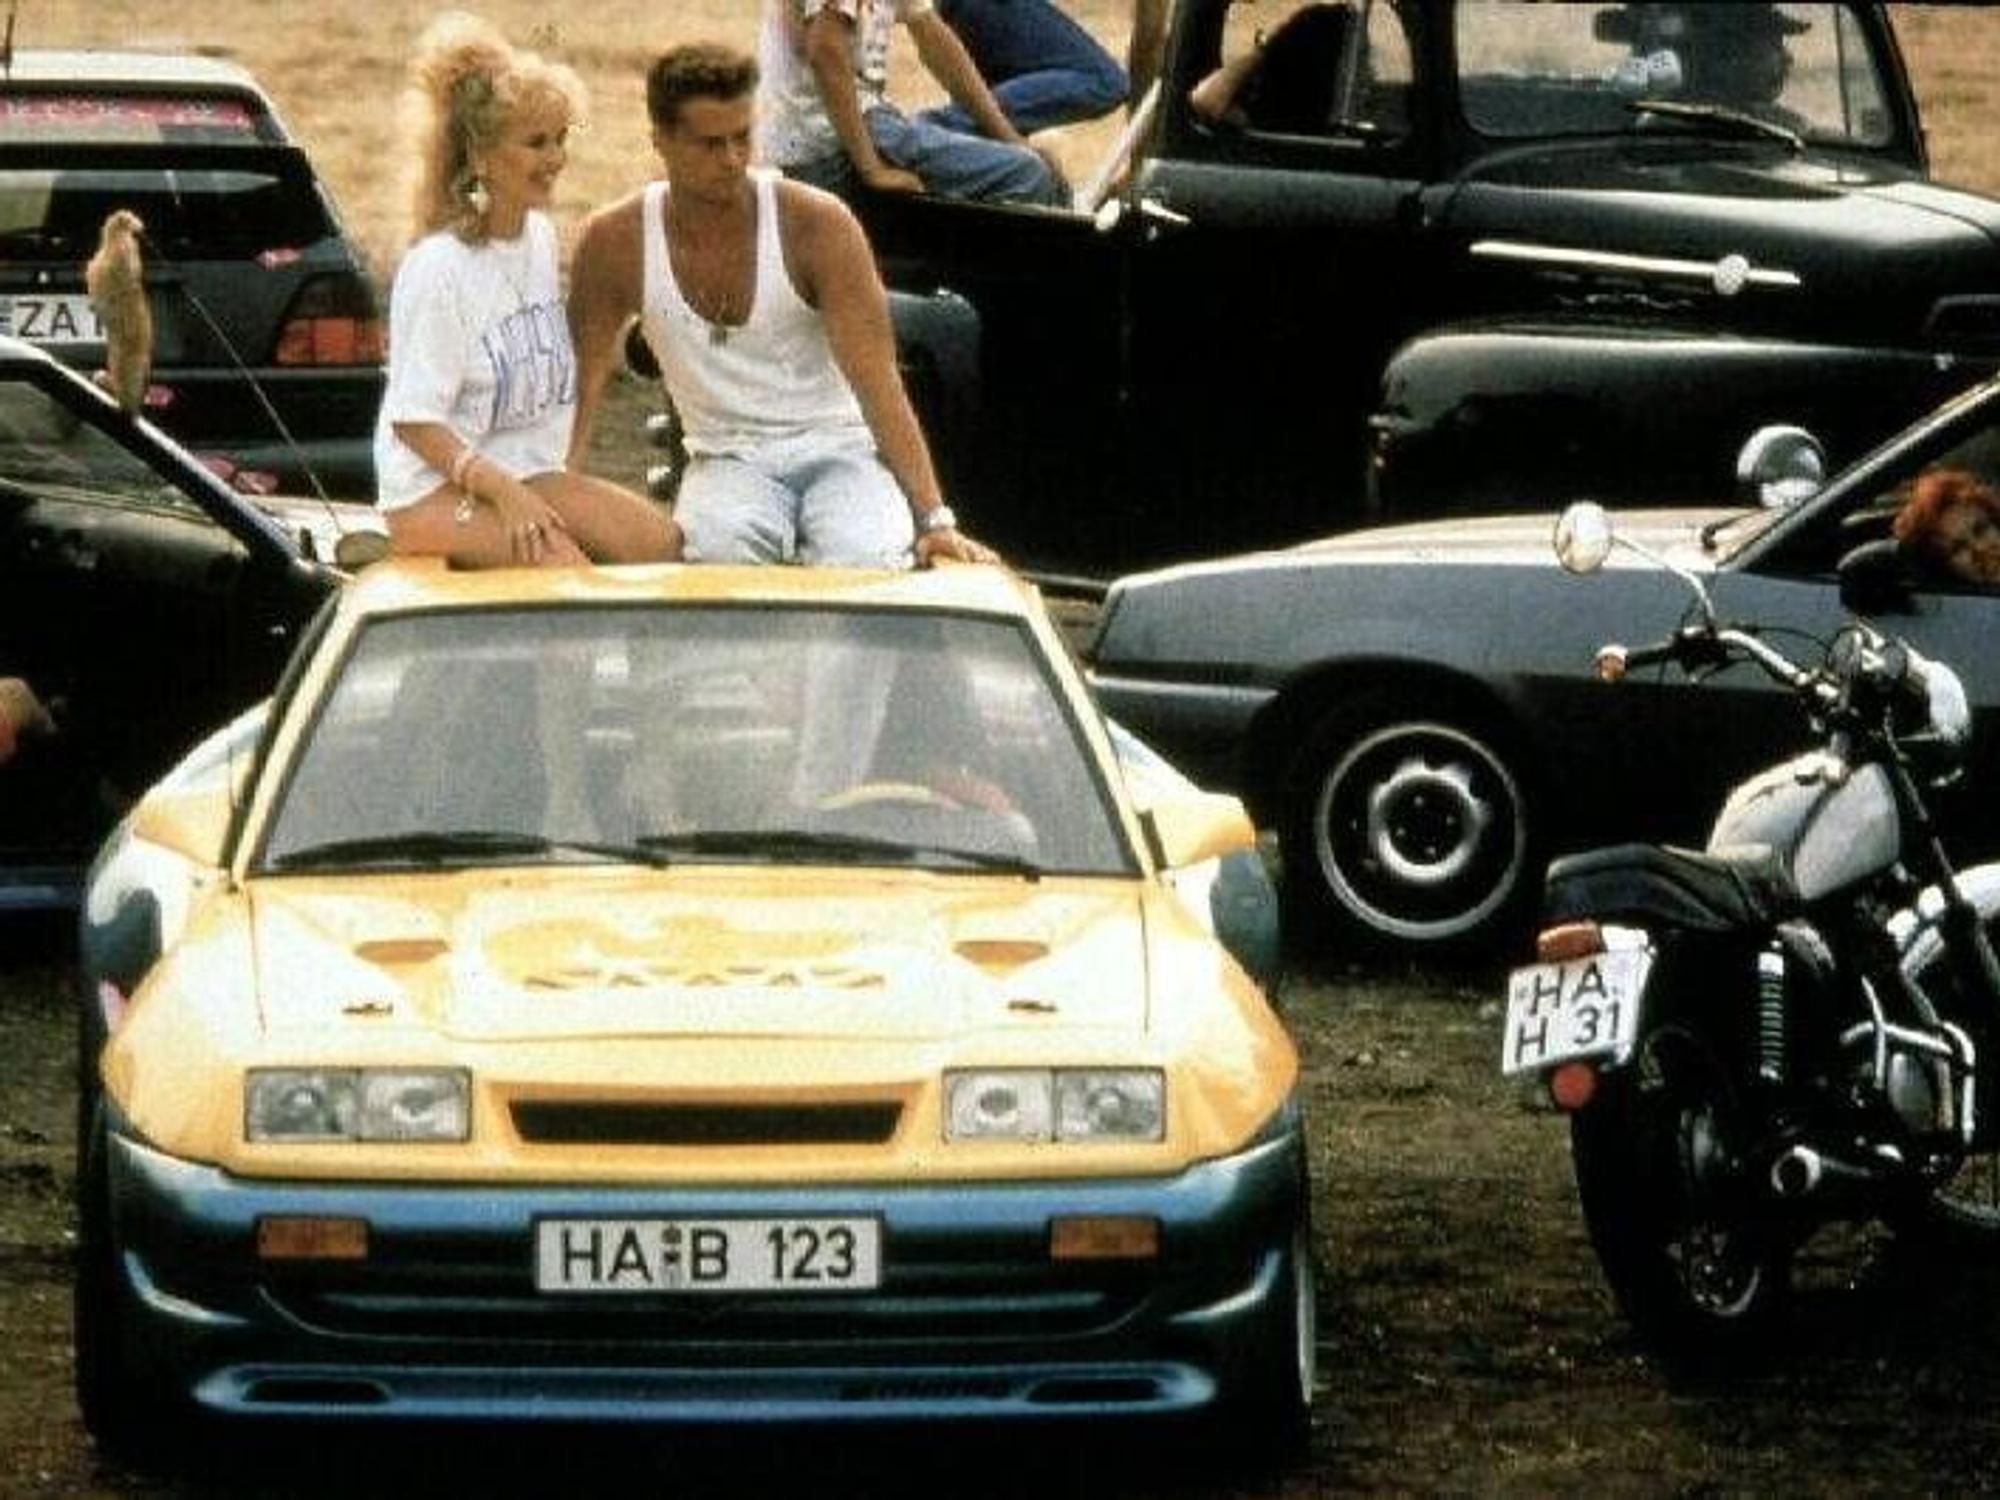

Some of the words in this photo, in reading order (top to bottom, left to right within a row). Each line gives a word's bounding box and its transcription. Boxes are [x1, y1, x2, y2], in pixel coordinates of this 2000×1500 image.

[1529, 962, 1607, 1015] HA
[1514, 1017, 1548, 1063] H
[1573, 1002, 1620, 1046] 31
[563, 1227, 652, 1281] HA
[690, 1228, 728, 1281] B
[768, 1226, 857, 1280] 123
